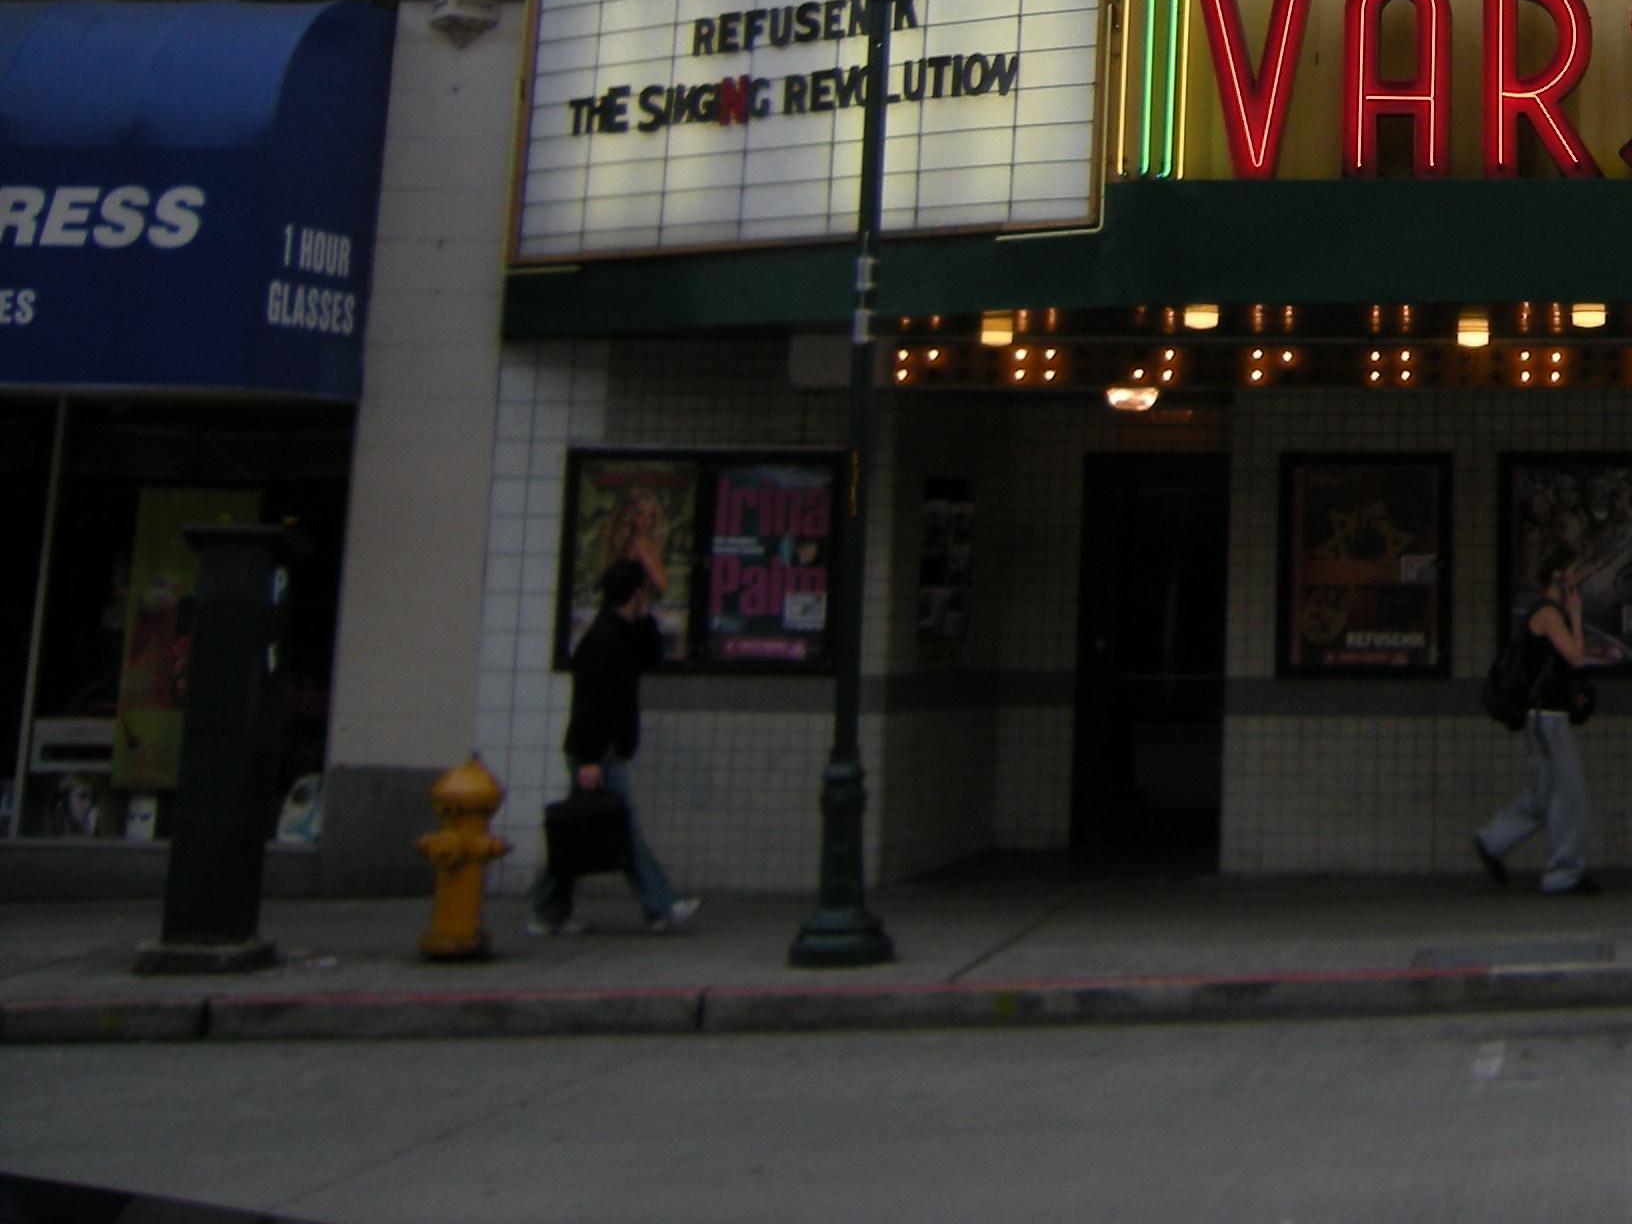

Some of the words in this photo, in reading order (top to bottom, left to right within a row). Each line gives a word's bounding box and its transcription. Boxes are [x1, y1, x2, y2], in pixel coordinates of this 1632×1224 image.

[568, 84, 631, 136] THE
[0, 184, 206, 249] RESS
[283, 223, 294, 267] 1
[298, 226, 352, 278] HOUR
[266, 279, 356, 336] GLASSES
[713, 473, 833, 538] Irina
